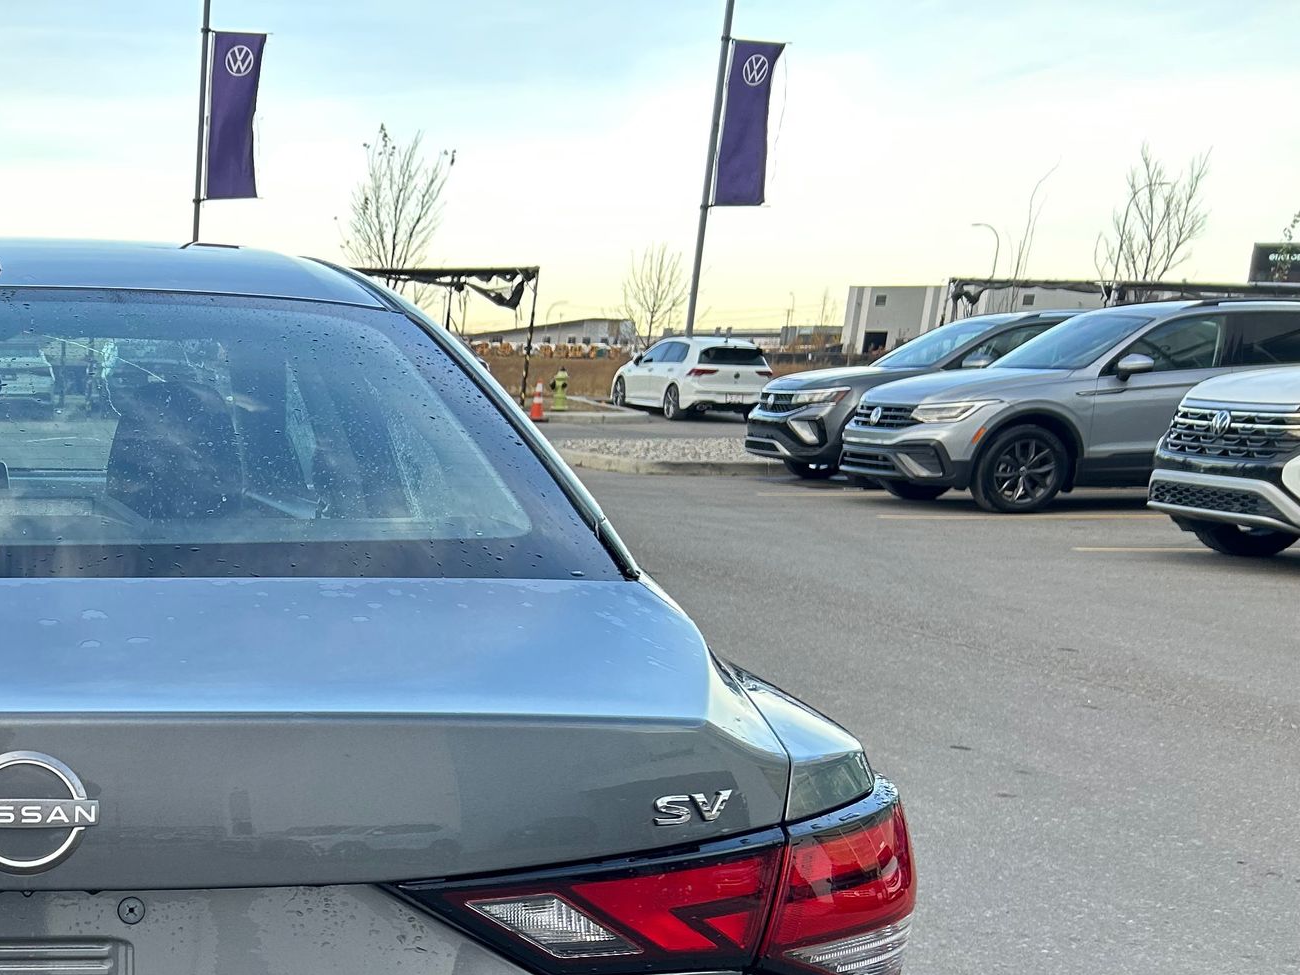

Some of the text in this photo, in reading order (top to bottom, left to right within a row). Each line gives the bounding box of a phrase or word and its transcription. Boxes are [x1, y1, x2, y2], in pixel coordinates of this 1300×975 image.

[225, 45, 254, 76] VW
[742, 54, 769, 86] VW
[652, 789, 733, 826] SV
